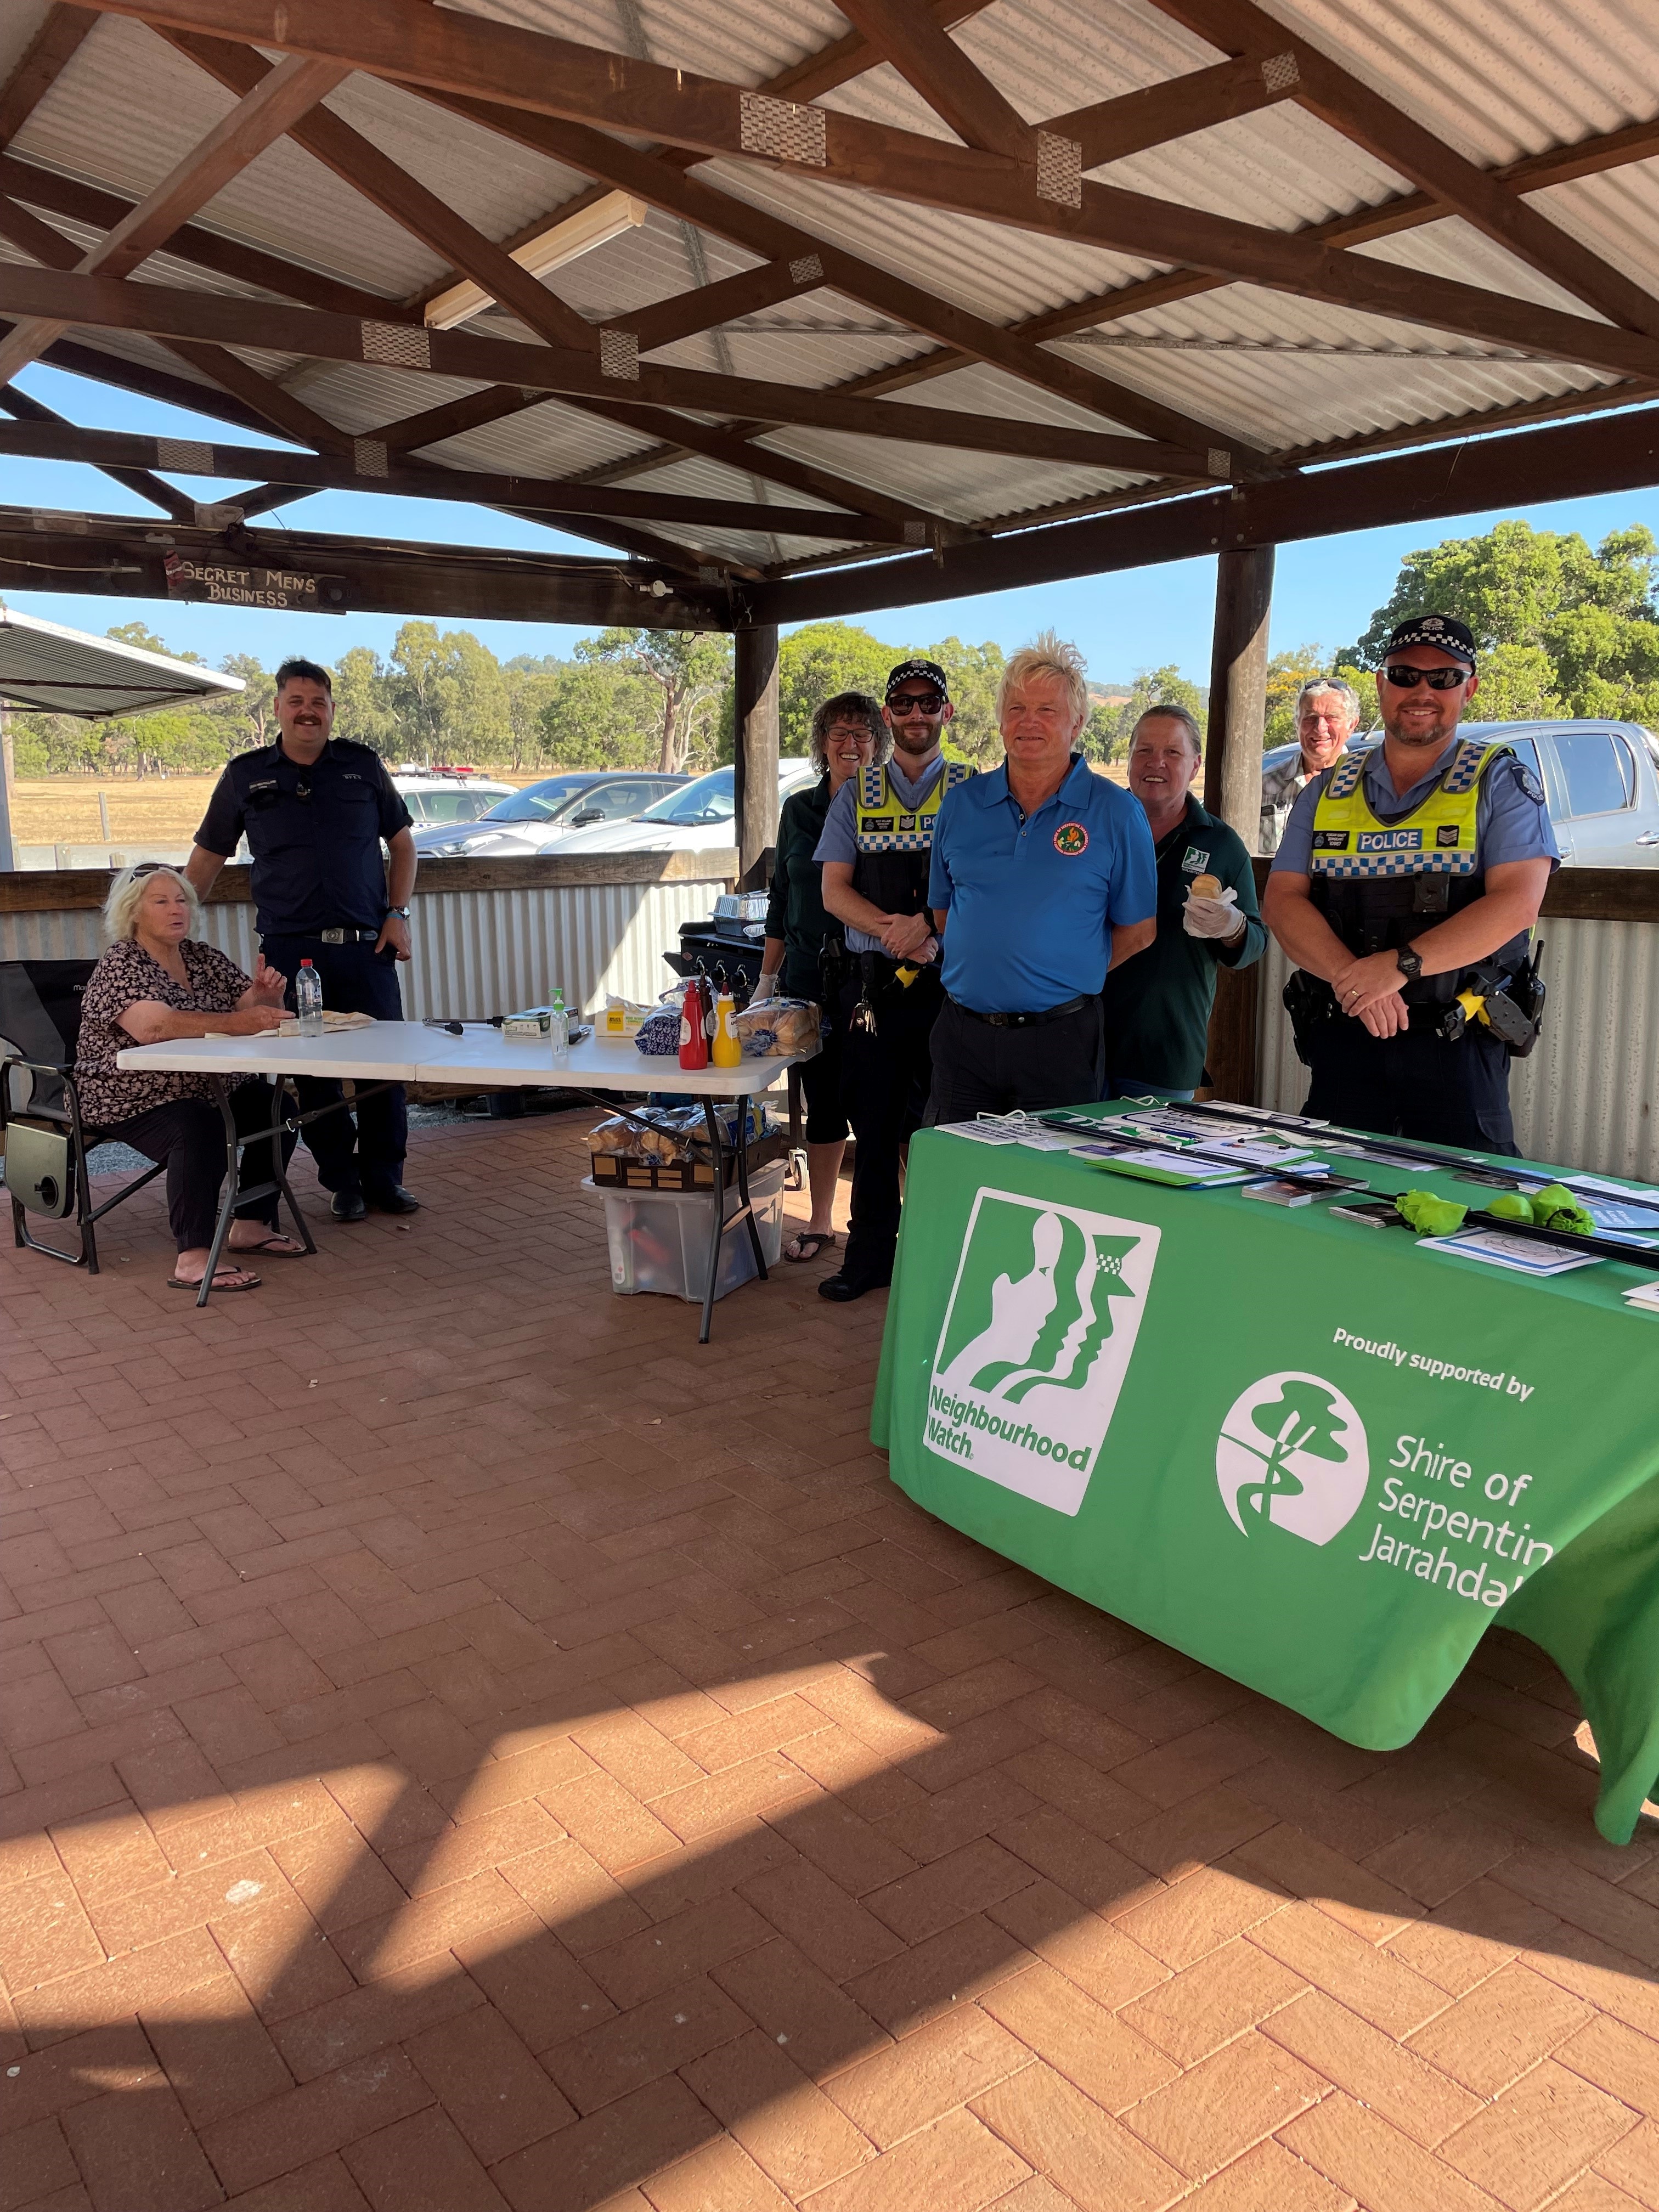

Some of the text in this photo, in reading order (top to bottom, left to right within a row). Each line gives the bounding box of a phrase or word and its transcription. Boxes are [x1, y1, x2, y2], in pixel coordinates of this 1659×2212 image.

[182, 561, 250, 585] SECRET
[205, 582, 288, 607] BUSINESS
[1361, 832, 1419, 850] POLICE
[1333, 1327, 1536, 1402] Proudly supported by
[930, 1385, 1092, 1472] Neighbourhood
[1389, 1435, 1533, 1506] Shire of
